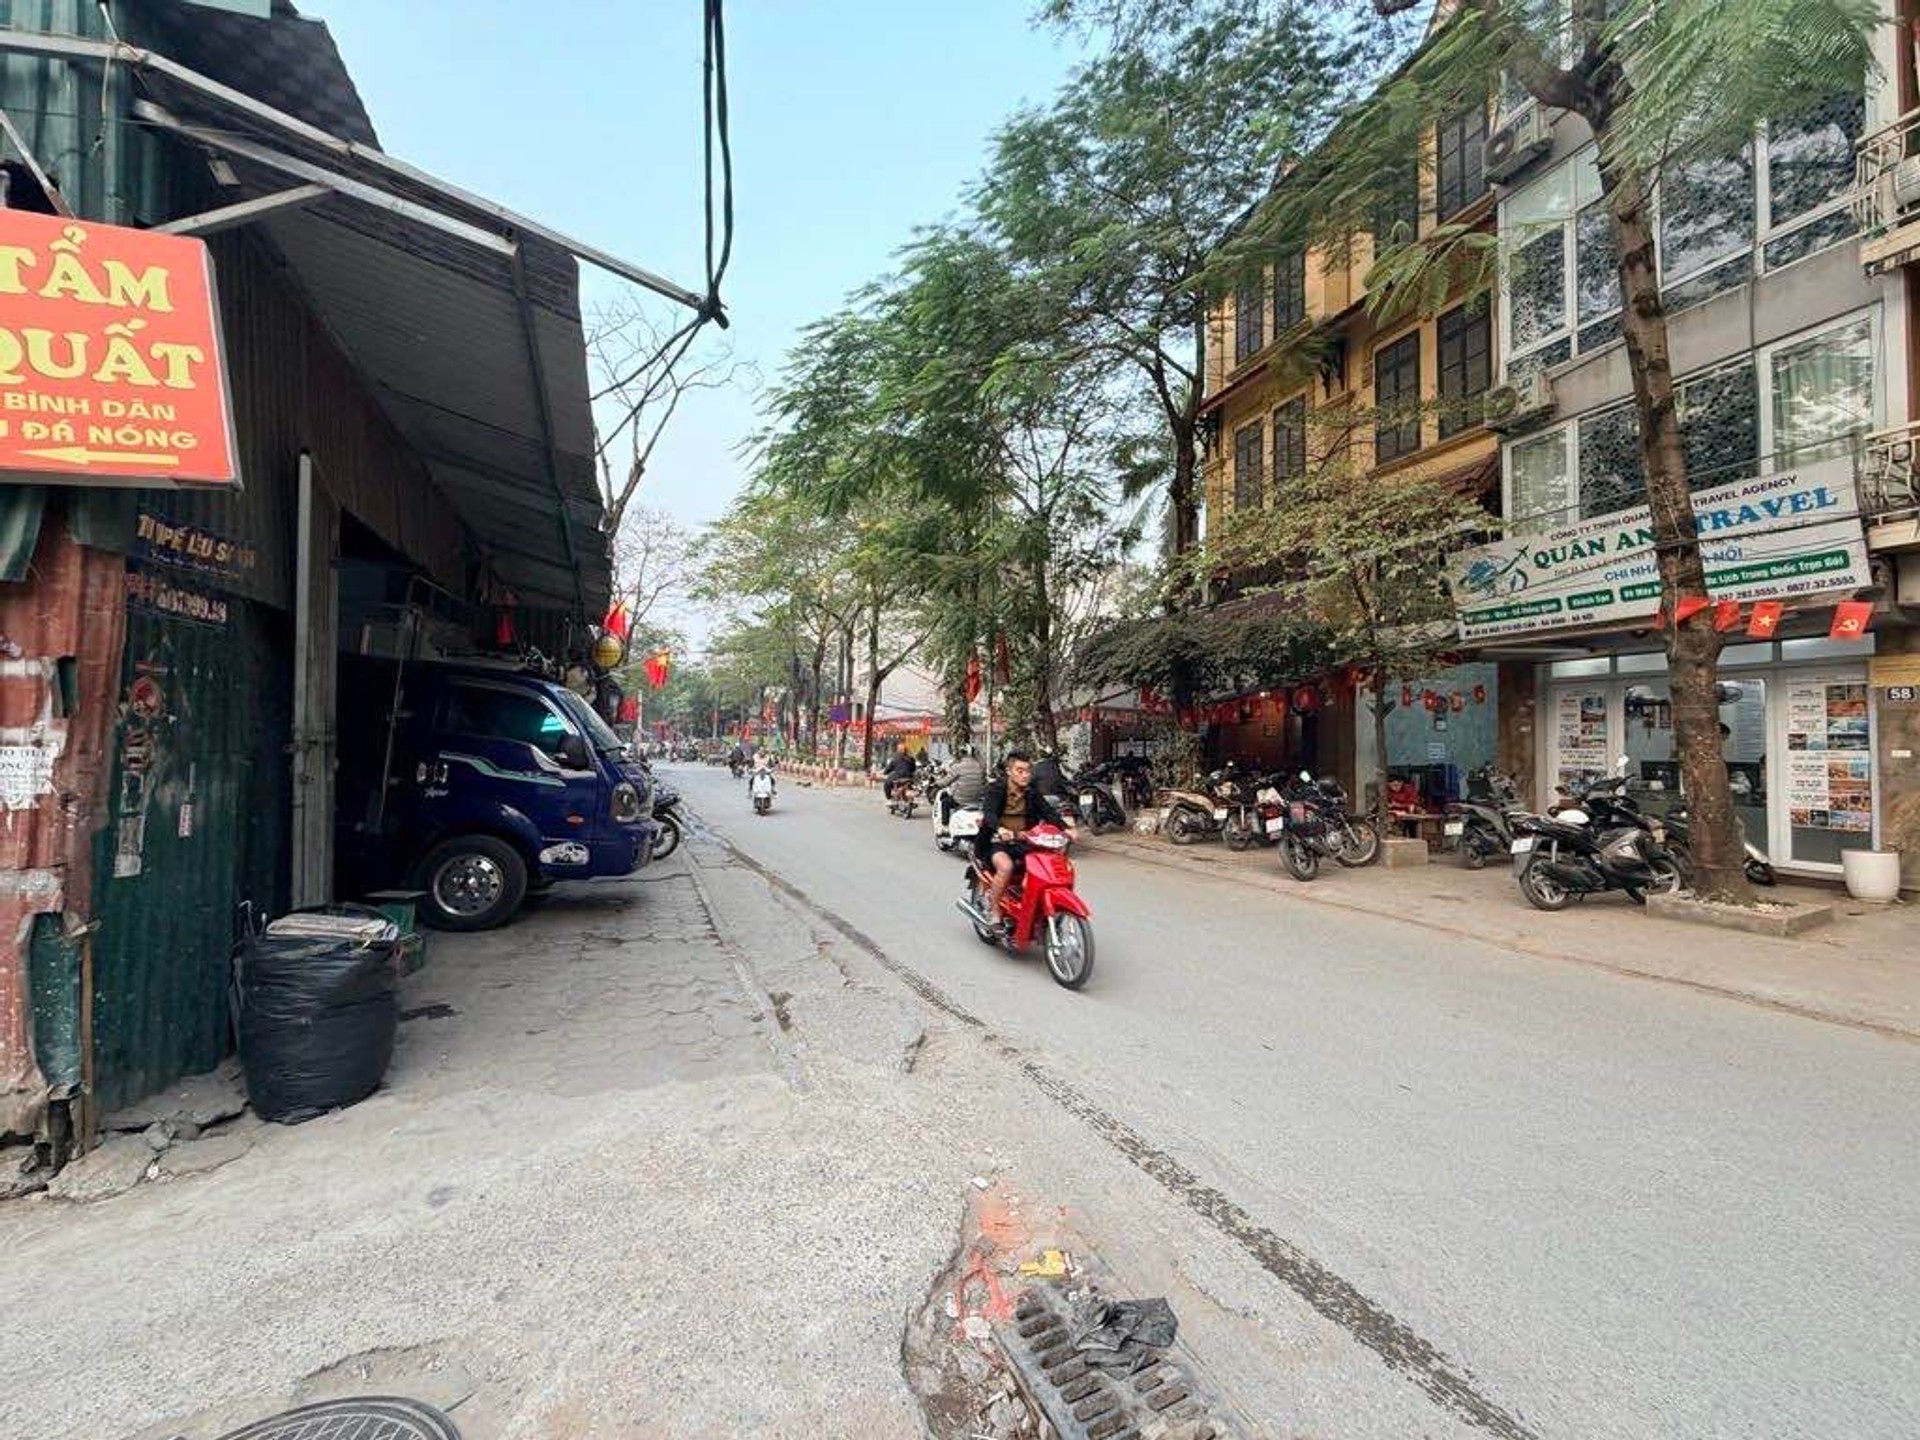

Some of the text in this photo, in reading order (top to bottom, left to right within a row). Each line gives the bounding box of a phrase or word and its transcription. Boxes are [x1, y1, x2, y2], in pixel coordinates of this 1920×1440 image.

[0, 226, 174, 312] TẨM
[102, 397, 176, 421] DÂN
[21, 419, 75, 442] ĐÁ
[88, 424, 198, 449] NÓNG
[1693, 489, 1738, 508] TRAVEL
[1741, 475, 1799, 496] AGENCY
[1533, 537, 1607, 569] QUÂN
[1694, 487, 1838, 534] TRAVEL
[1889, 688, 1912, 699] 58
